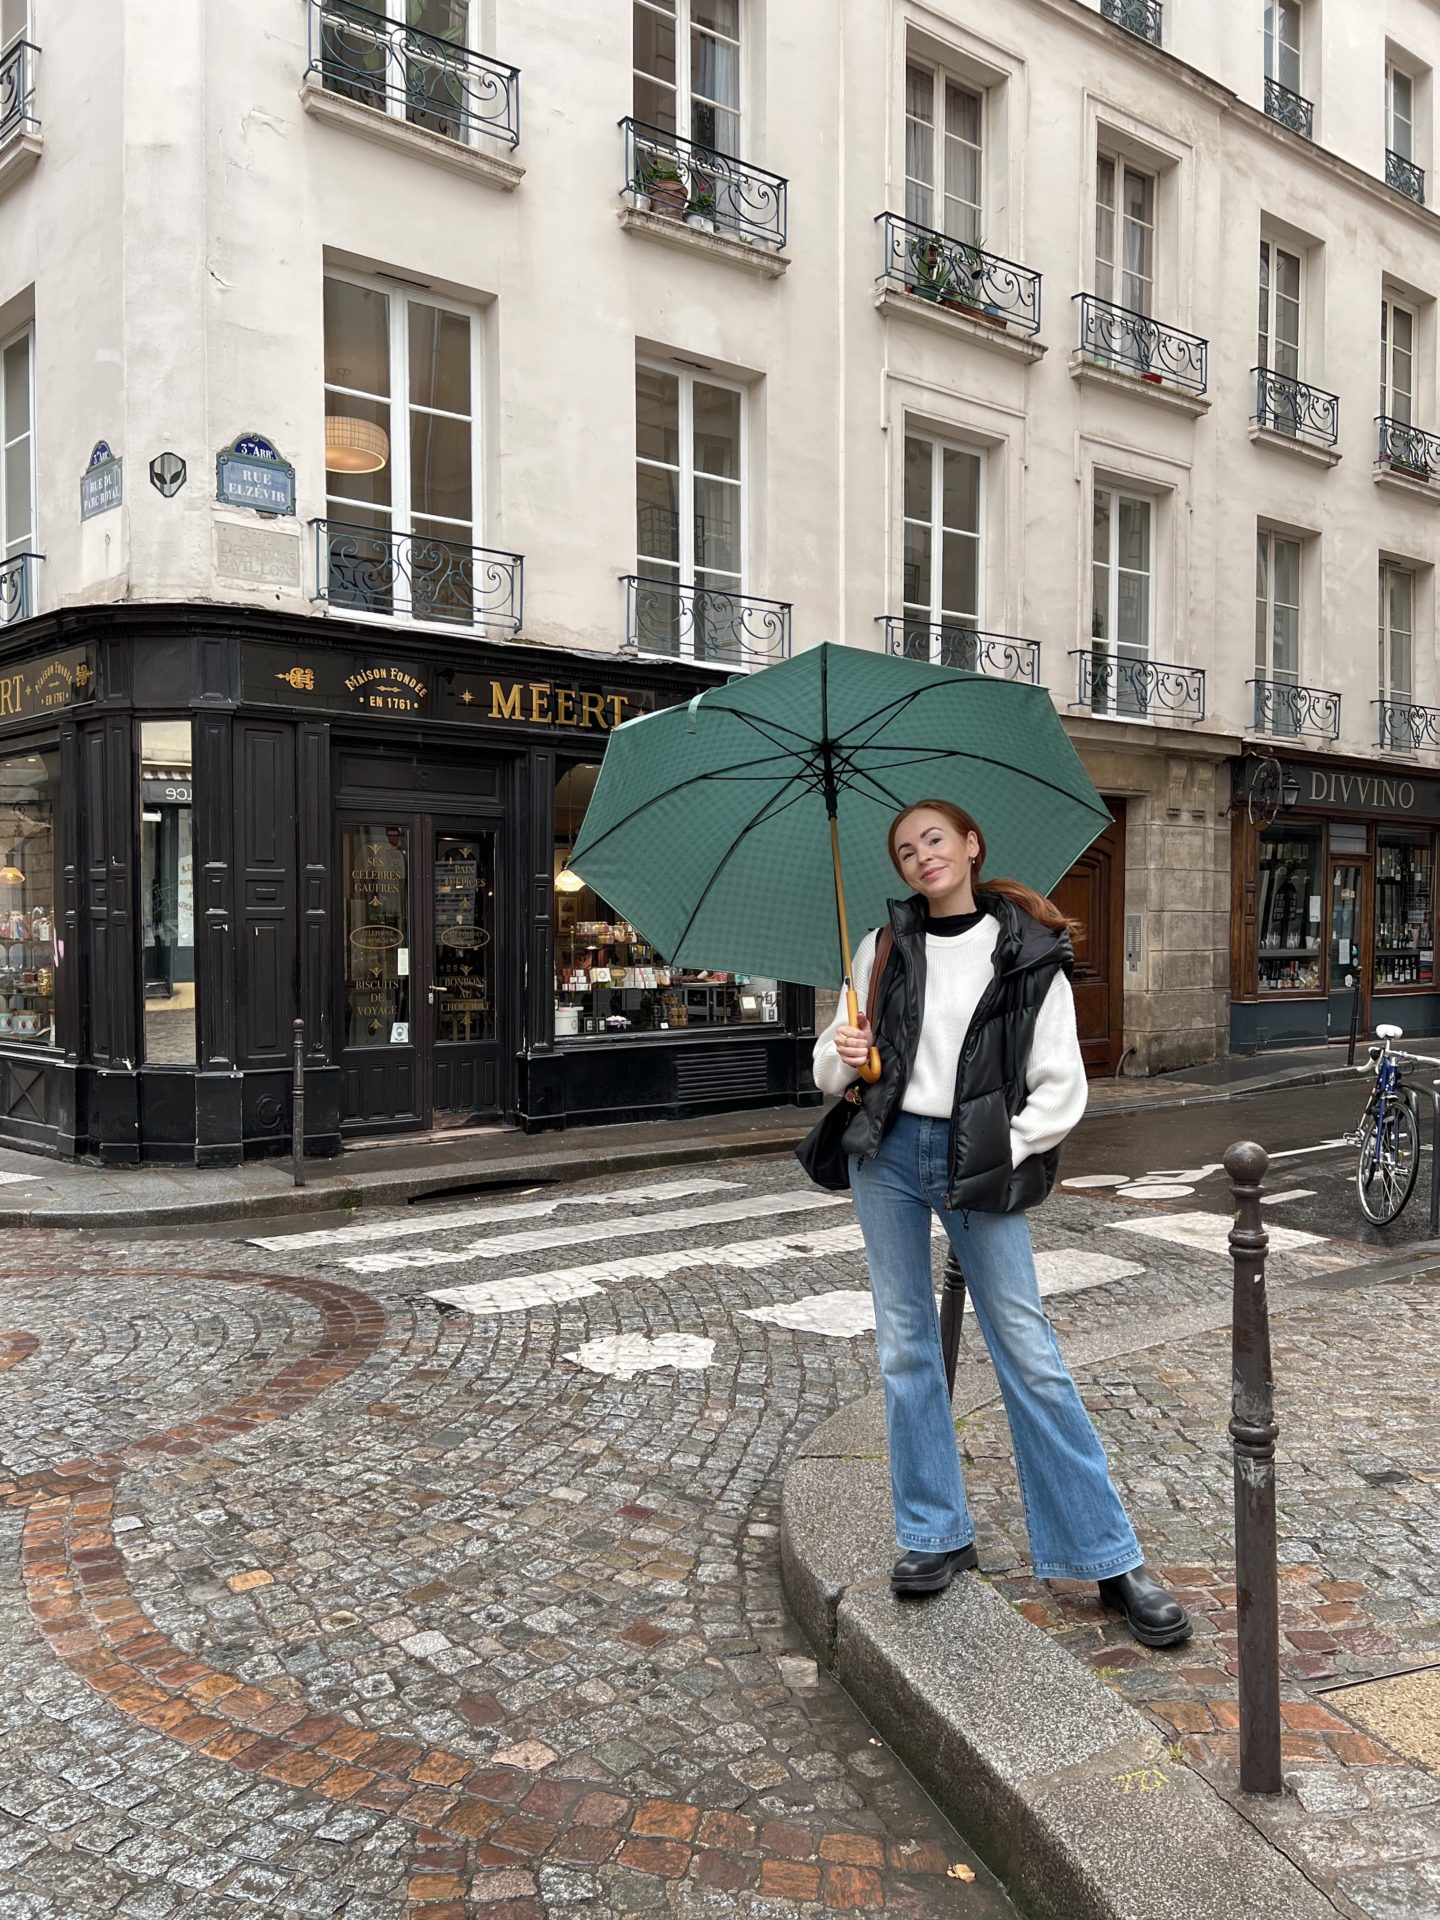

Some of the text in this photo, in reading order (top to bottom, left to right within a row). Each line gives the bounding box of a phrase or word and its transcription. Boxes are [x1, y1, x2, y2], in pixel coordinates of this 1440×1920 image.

[242, 469, 271, 485] RUE
[90, 473, 112, 493] RUE DU
[228, 482, 285, 503] ELZÉVIR
[45, 691, 65, 706] EN 1761
[369, 695, 411, 710] EN 1761
[1309, 771, 1415, 809] DIVVINO
[367, 856, 384, 867] SES
[455, 864, 475, 874] PAIN
[354, 882, 399, 893] GAUFRES
[356, 980, 399, 990] BISCUITS
[445, 977, 487, 987] BONBONS
[370, 993, 384, 1003] DE
[357, 1006, 398, 1016] VOYAGE
